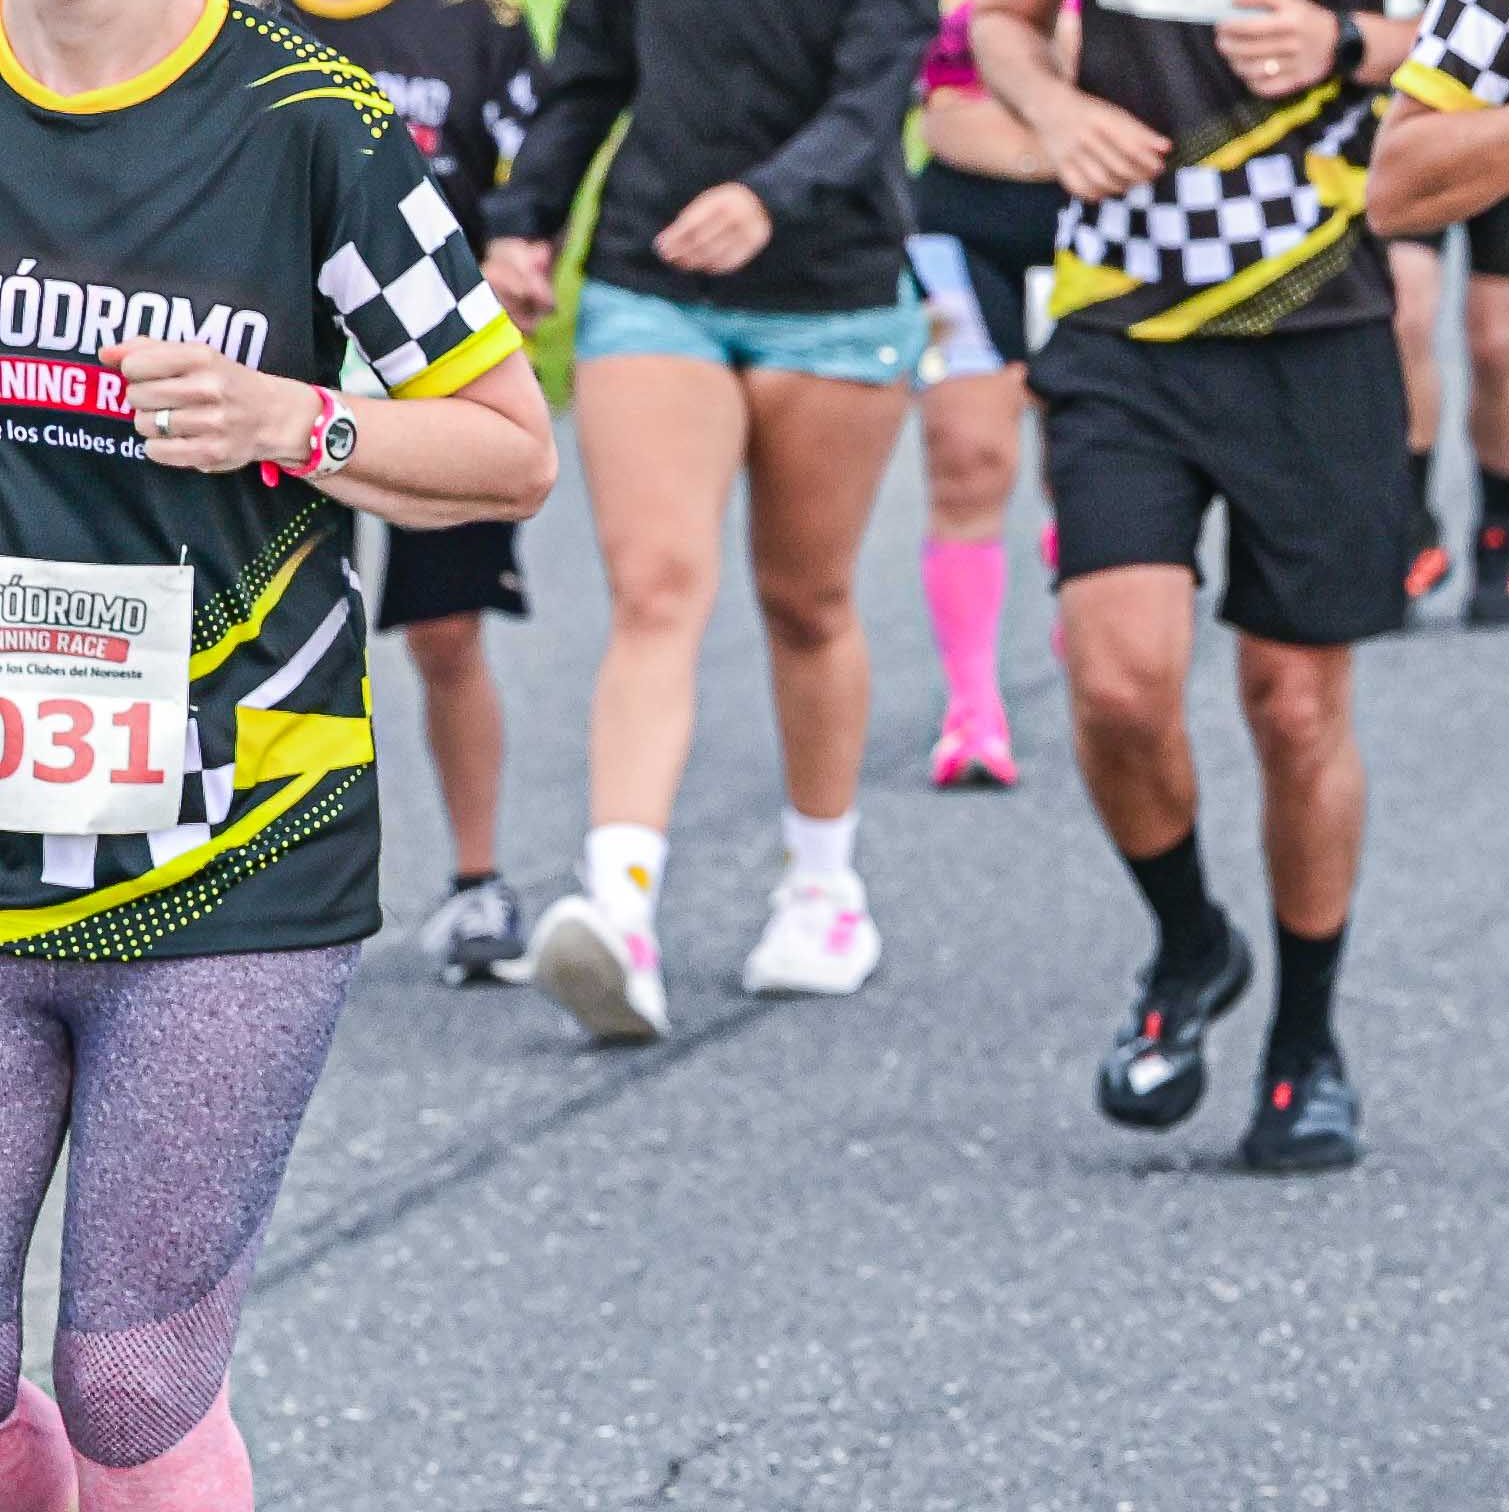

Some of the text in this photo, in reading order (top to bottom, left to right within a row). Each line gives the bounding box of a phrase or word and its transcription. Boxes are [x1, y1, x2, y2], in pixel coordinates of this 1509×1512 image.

[0, 258, 269, 371] ÓDROMO
[7, 419, 39, 443] los
[43, 424, 116, 453] Clubes
[0, 574, 147, 635] ÓDROMO
[56, 632, 109, 658] RACE
[27, 663, 66, 676] Clubes
[69, 666, 88, 678] del
[91, 667, 143, 680] Noroeste
